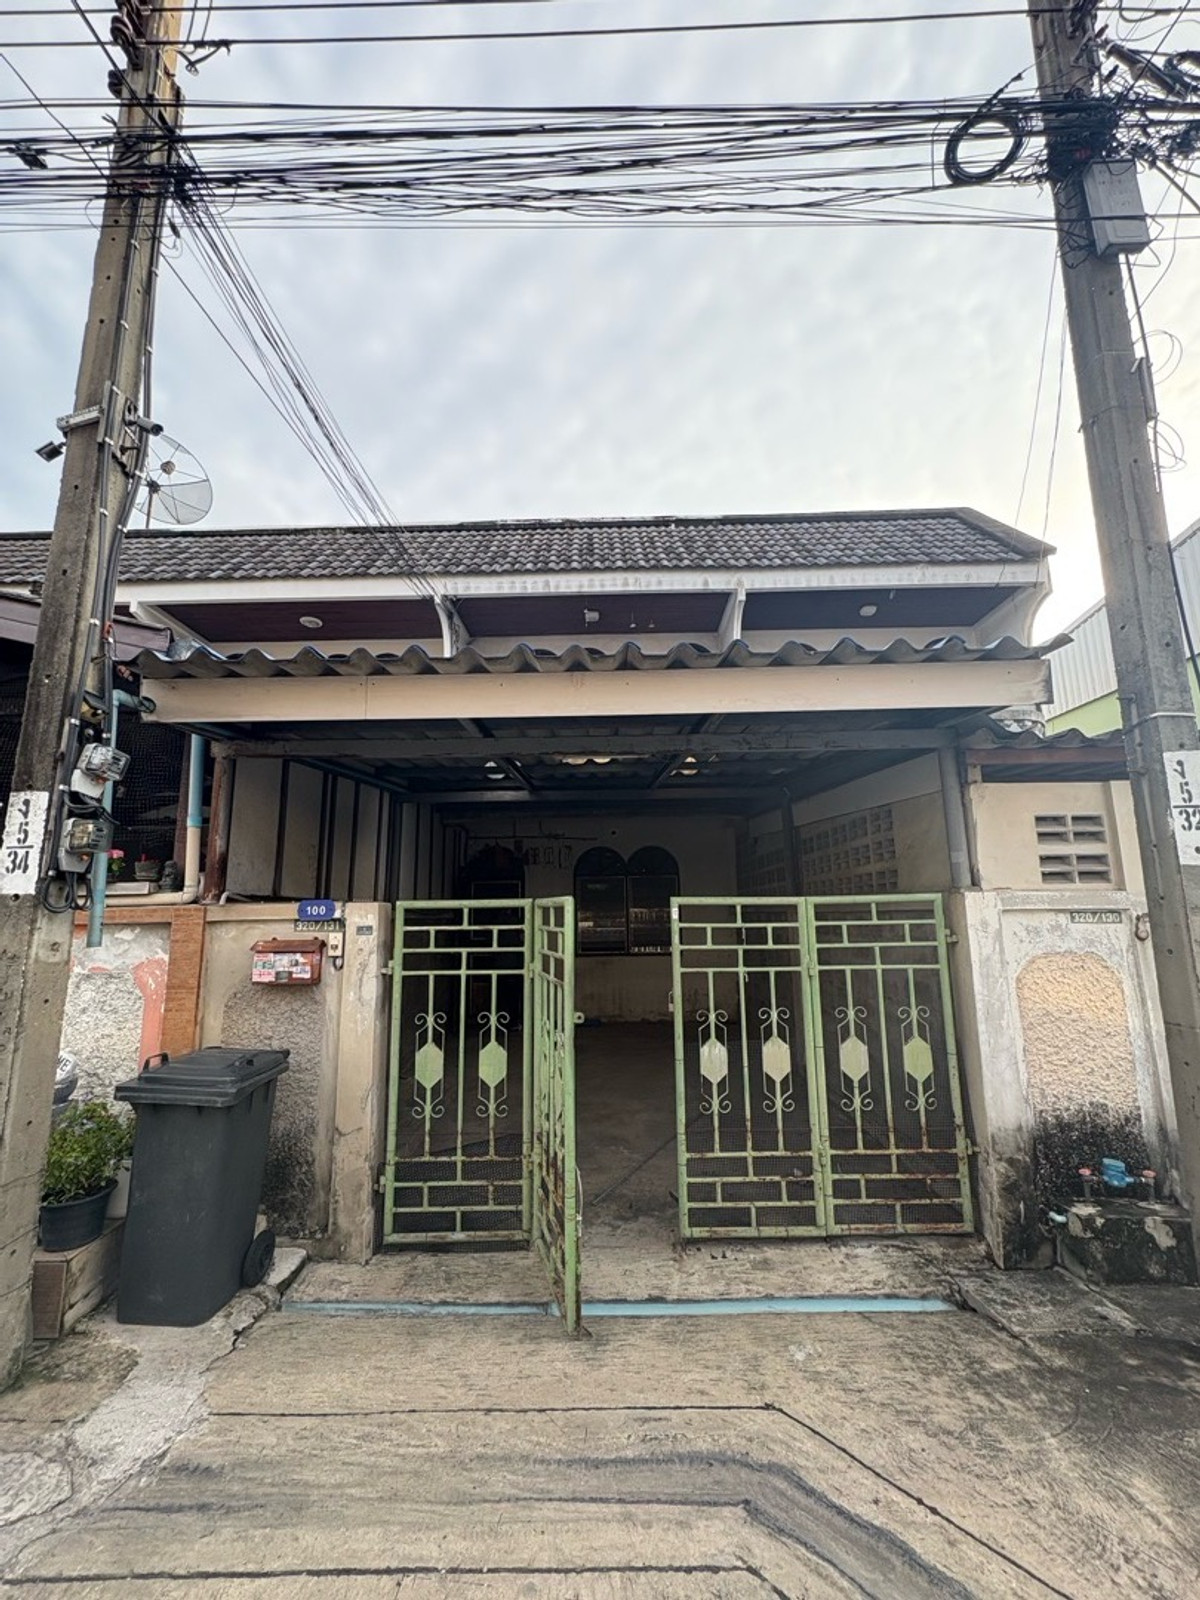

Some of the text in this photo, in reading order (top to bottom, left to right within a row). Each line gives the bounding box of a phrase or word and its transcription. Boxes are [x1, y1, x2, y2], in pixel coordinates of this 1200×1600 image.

[1179, 780, 1193, 804] 5
[16, 820, 29, 845] 5
[5, 850, 29, 874] 34
[305, 905, 326, 916] 100
[1072, 912, 1120, 923] 320/130
[296, 920, 340, 931] 320/131
